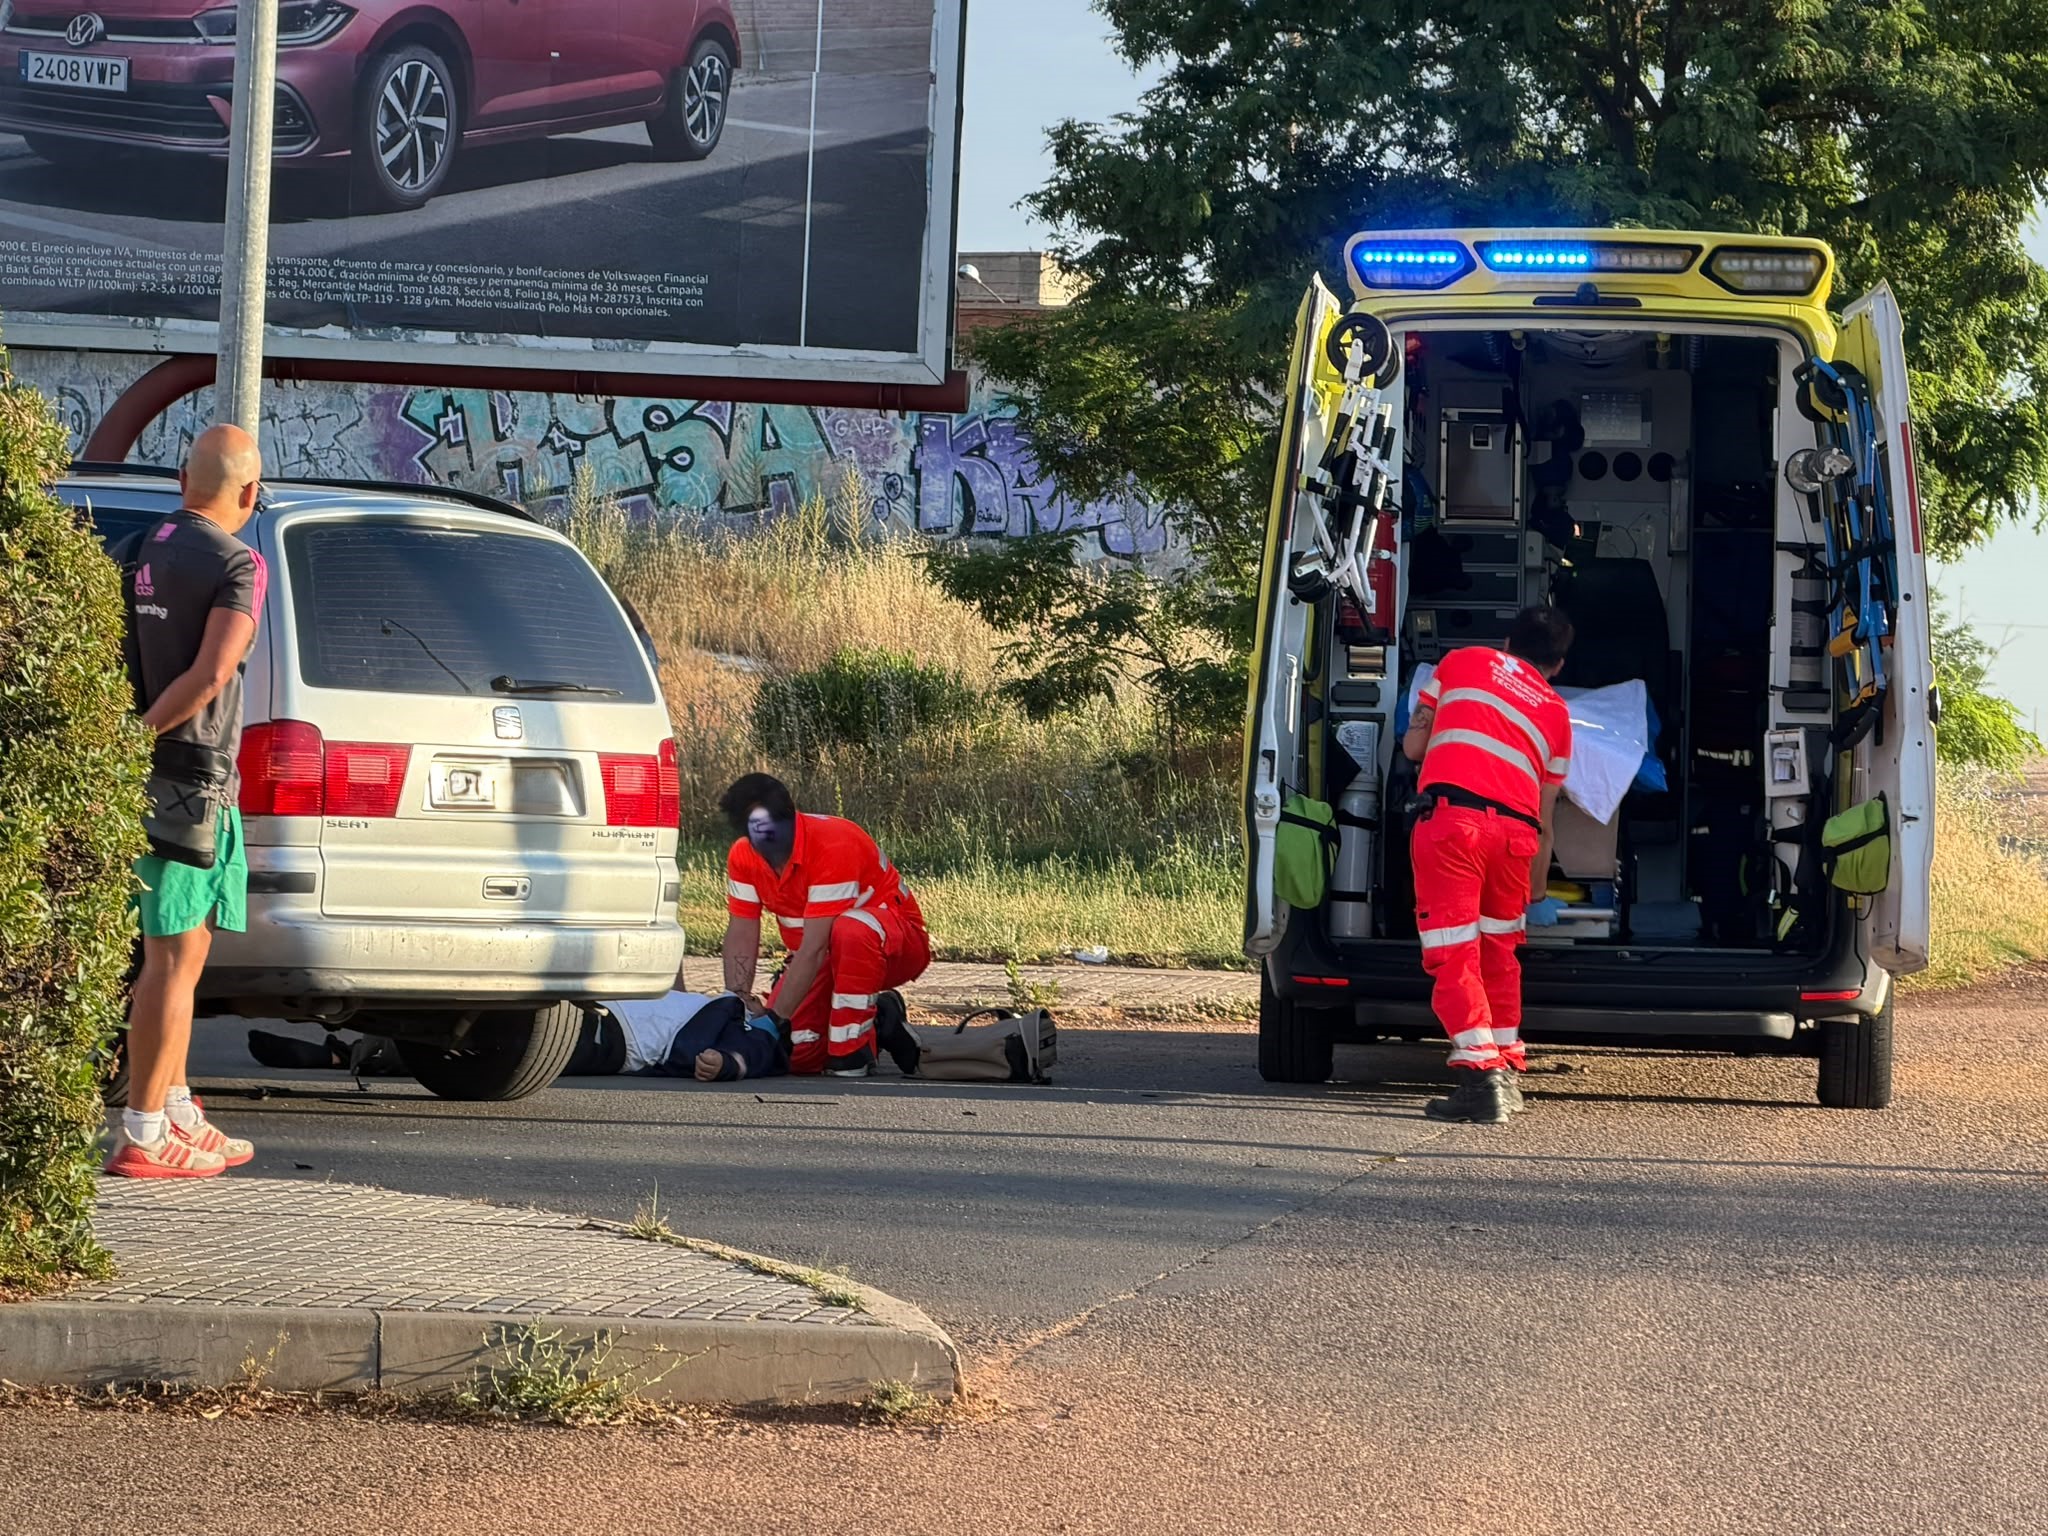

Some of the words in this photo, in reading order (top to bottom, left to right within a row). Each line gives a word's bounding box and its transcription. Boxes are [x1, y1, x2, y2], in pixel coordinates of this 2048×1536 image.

[33, 57, 81, 82] 2408
[83, 60, 122, 86] VWP
[31, 241, 41, 252] El
[43, 243, 74, 255] precio
[76, 244, 112, 257] incluye
[114, 246, 133, 258] IVA,
[189, 250, 202, 261] de
[204, 252, 224, 262] mat
[276, 256, 330, 268] transporte,
[379, 260, 392, 270] de
[394, 261, 425, 271] marca
[427, 263, 433, 274] y
[435, 263, 505, 276] concesionario,
[507, 267, 514, 277] y
[587, 269, 601, 280] de
[602, 270, 661, 284] Volkswagen
[664, 272, 709, 284] Financial
[34, 254, 63, 266] según
[65, 256, 123, 268] condiciones
[125, 259, 166, 271] actuales
[168, 263, 186, 272] con
[188, 264, 202, 273] un
[278, 266, 291, 276] de
[293, 267, 327, 278] 14.000
[377, 270, 414, 282] mínima
[416, 272, 430, 283] de
[431, 273, 445, 284] 60
[446, 275, 478, 286] meses
[480, 277, 487, 288] y
[551, 279, 589, 292] mínima
[590, 281, 604, 292] de
[605, 282, 619, 293] 36
[621, 283, 654, 294] meses.
[657, 283, 703, 297] Campaña
[1, 275, 56, 287] combinado
[57, 277, 86, 288] WLTP
[279, 289, 291, 299] de
[374, 293, 393, 305] 119
[403, 295, 422, 306] 128
[424, 296, 453, 308] g/km.
[455, 297, 493, 309] Modelo
[548, 303, 570, 314] Polo
[573, 303, 593, 315] Más
[595, 306, 614, 316] con
[615, 306, 671, 318] opcionales.
[6, 263, 30, 274] Bank
[32, 264, 63, 276] GmbH
[65, 266, 83, 277] S.E.
[85, 267, 112, 278] Avda.
[114, 268, 158, 283] Bruselas,
[160, 272, 173, 283] 34
[183, 273, 216, 285] 28108
[278, 277, 300, 290] Reg.
[358, 281, 395, 293] Madrid.
[397, 283, 425, 294] Tomo
[428, 284, 462, 297] 16828,
[464, 286, 502, 299] Sección
[503, 288, 513, 299] 8,
[515, 288, 540, 300] Folio
[541, 290, 562, 302] 184,
[564, 291, 587, 304] Hoja
[590, 292, 644, 306] M-287573,
[685, 298, 704, 308] con
